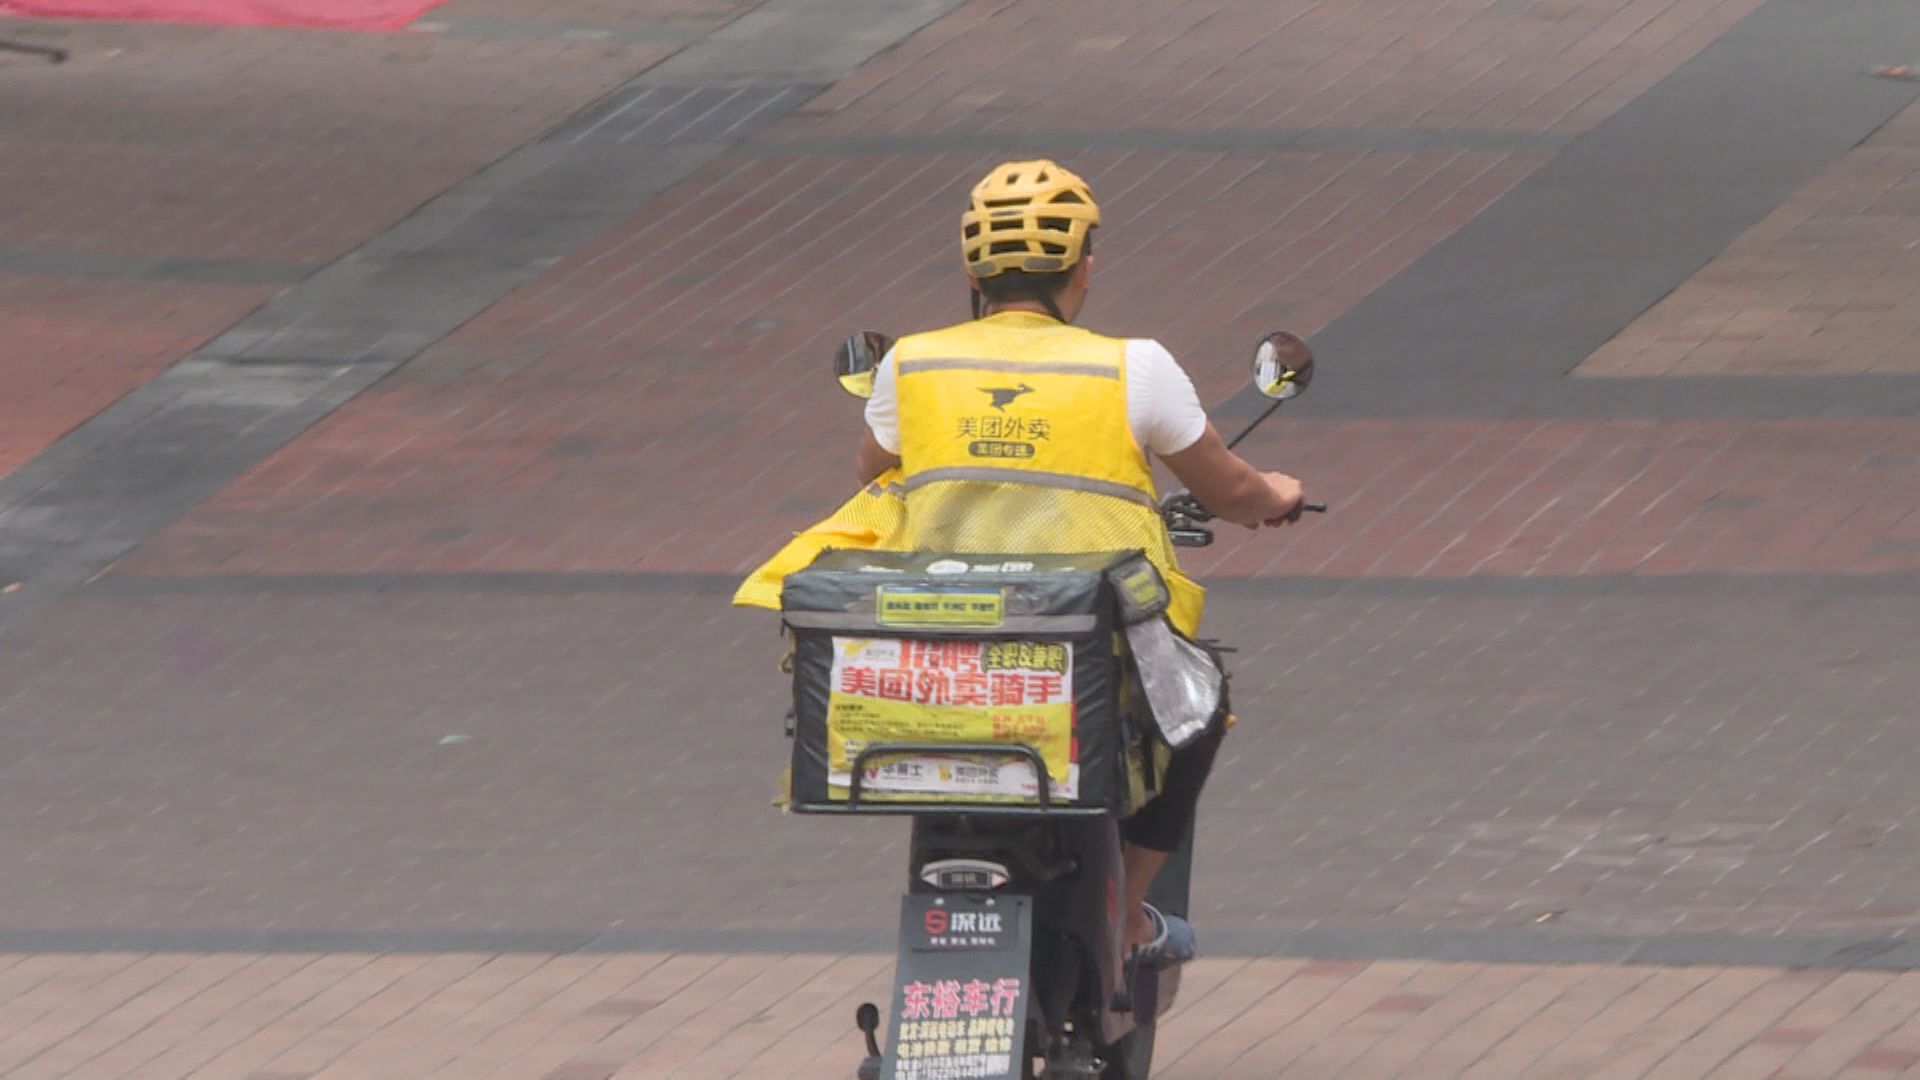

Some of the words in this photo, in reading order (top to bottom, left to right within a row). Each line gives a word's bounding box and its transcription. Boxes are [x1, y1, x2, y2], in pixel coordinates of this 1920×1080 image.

[956, 414, 1051, 440] 美团外卖
[986, 641, 1065, 671] 全职&兼职
[841, 667, 1063, 706] 美团外卖骑手
[951, 912, 1002, 932] 深远
